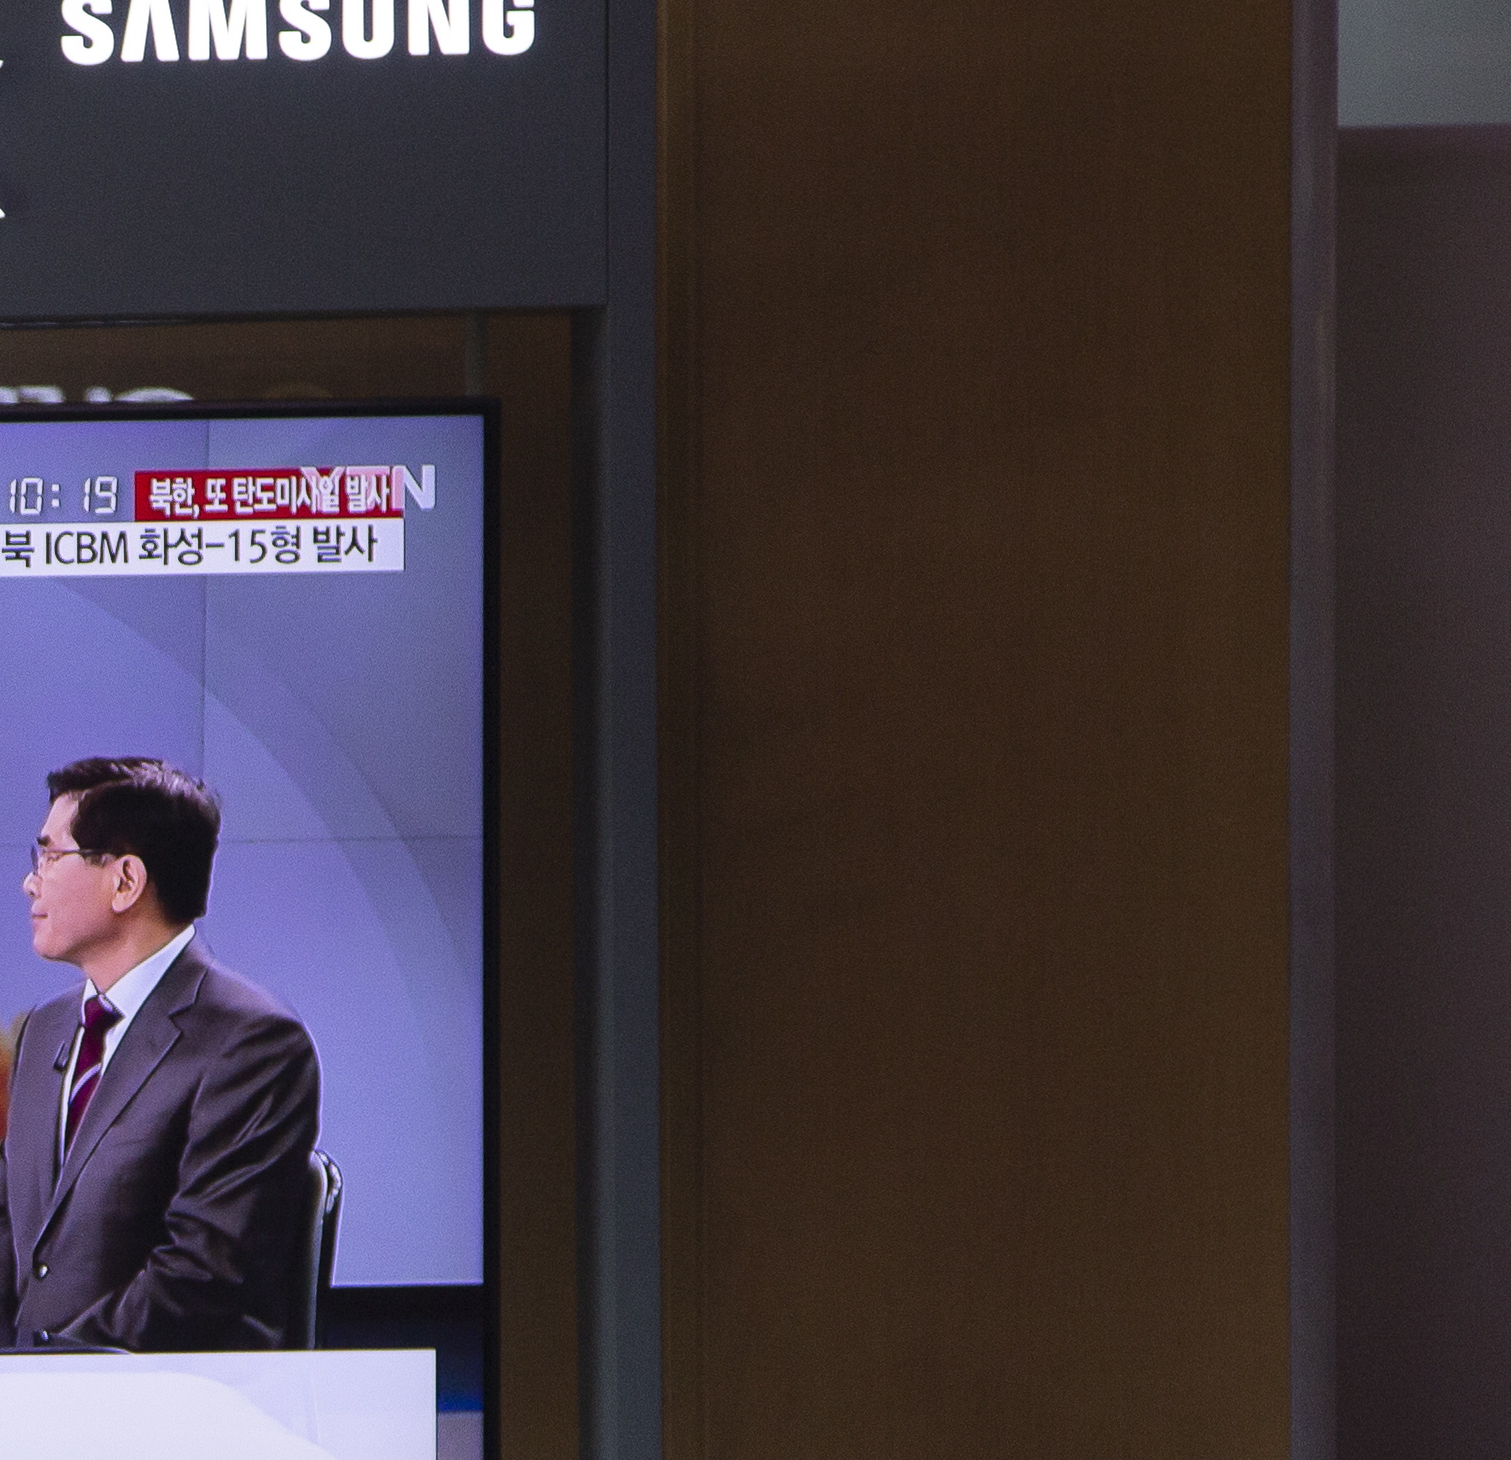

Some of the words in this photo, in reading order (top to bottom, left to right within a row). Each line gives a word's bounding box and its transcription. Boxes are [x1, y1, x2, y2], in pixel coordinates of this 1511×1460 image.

[60, 0, 535, 66] SAMSUNG
[149, 476, 200, 519] 북한,
[203, 477, 228, 513] 또
[231, 474, 340, 515] 탄도미사일
[344, 474, 391, 514] 발사
[1, 530, 35, 568] 북
[45, 531, 129, 565] ICBM
[138, 525, 301, 566] 화성-15형
[312, 524, 378, 564] 발사
